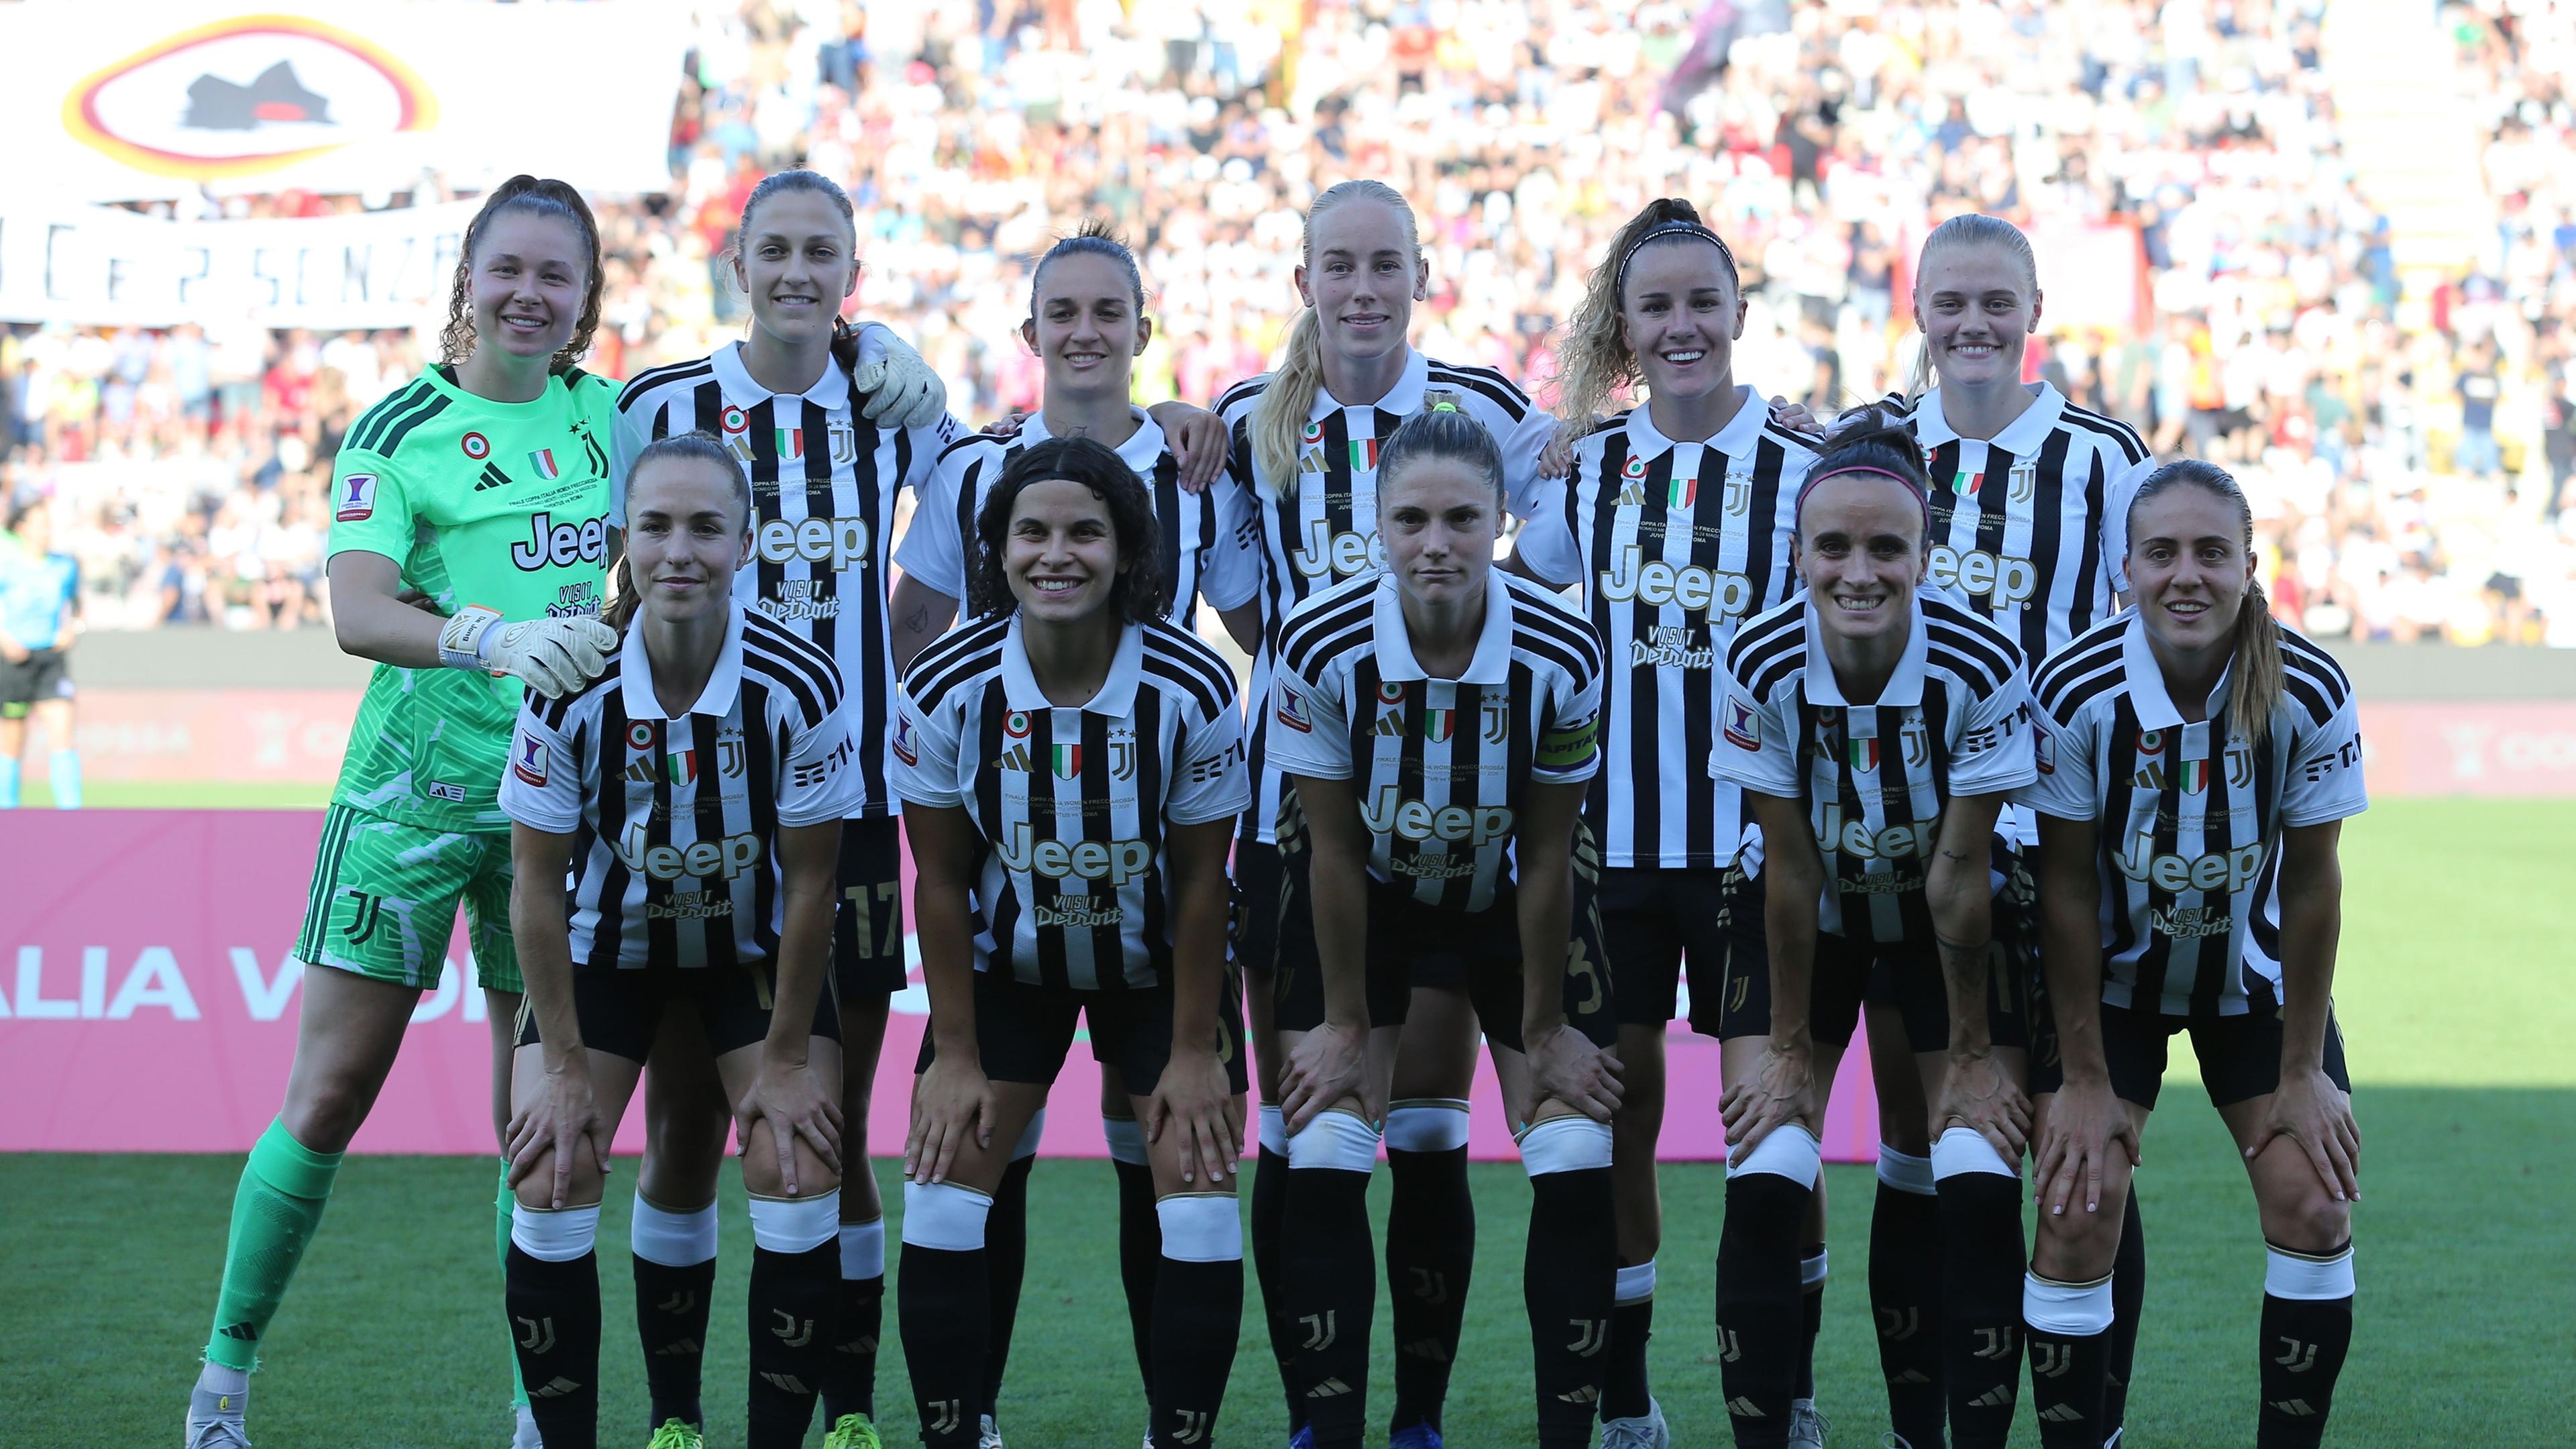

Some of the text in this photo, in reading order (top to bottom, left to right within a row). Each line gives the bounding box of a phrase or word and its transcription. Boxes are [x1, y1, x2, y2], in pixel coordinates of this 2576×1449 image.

[541, 490, 556, 499] ITALIA
[1600, 544, 1754, 625] Jeep
[1926, 544, 2038, 610] eep
[559, 581, 592, 604] VISIT
[775, 580, 824, 598] VISIT
[462, 616, 487, 642] De Jong
[1647, 624, 1697, 646] VISIT
[1629, 638, 1715, 669] Detroit
[1457, 763, 1505, 771] FRECCIAROSSA
[1005, 793, 1026, 801] FINALE
[1088, 796, 1136, 805] FRECCIAROSSA
[1041, 808, 1071, 818] JUVENTUS
[1356, 785, 1515, 848] Jeep
[609, 822, 764, 882] Jeep
[991, 821, 1154, 888] Jeep
[1409, 853, 1460, 866] VISIT
[2110, 830, 2265, 896] Jeep
[1390, 857, 1477, 880] Detroit
[1854, 870, 1906, 884] VISIT
[1835, 876, 1927, 895] Detroit
[663, 890, 714, 904] VISIT
[1051, 894, 1102, 910] VISIT
[645, 898, 734, 920] Detroit
[845, 879, 899, 959] 17
[1032, 905, 1123, 927] Detroit
[2166, 904, 2214, 922] VISIT
[2151, 908, 2233, 939] Detroit
